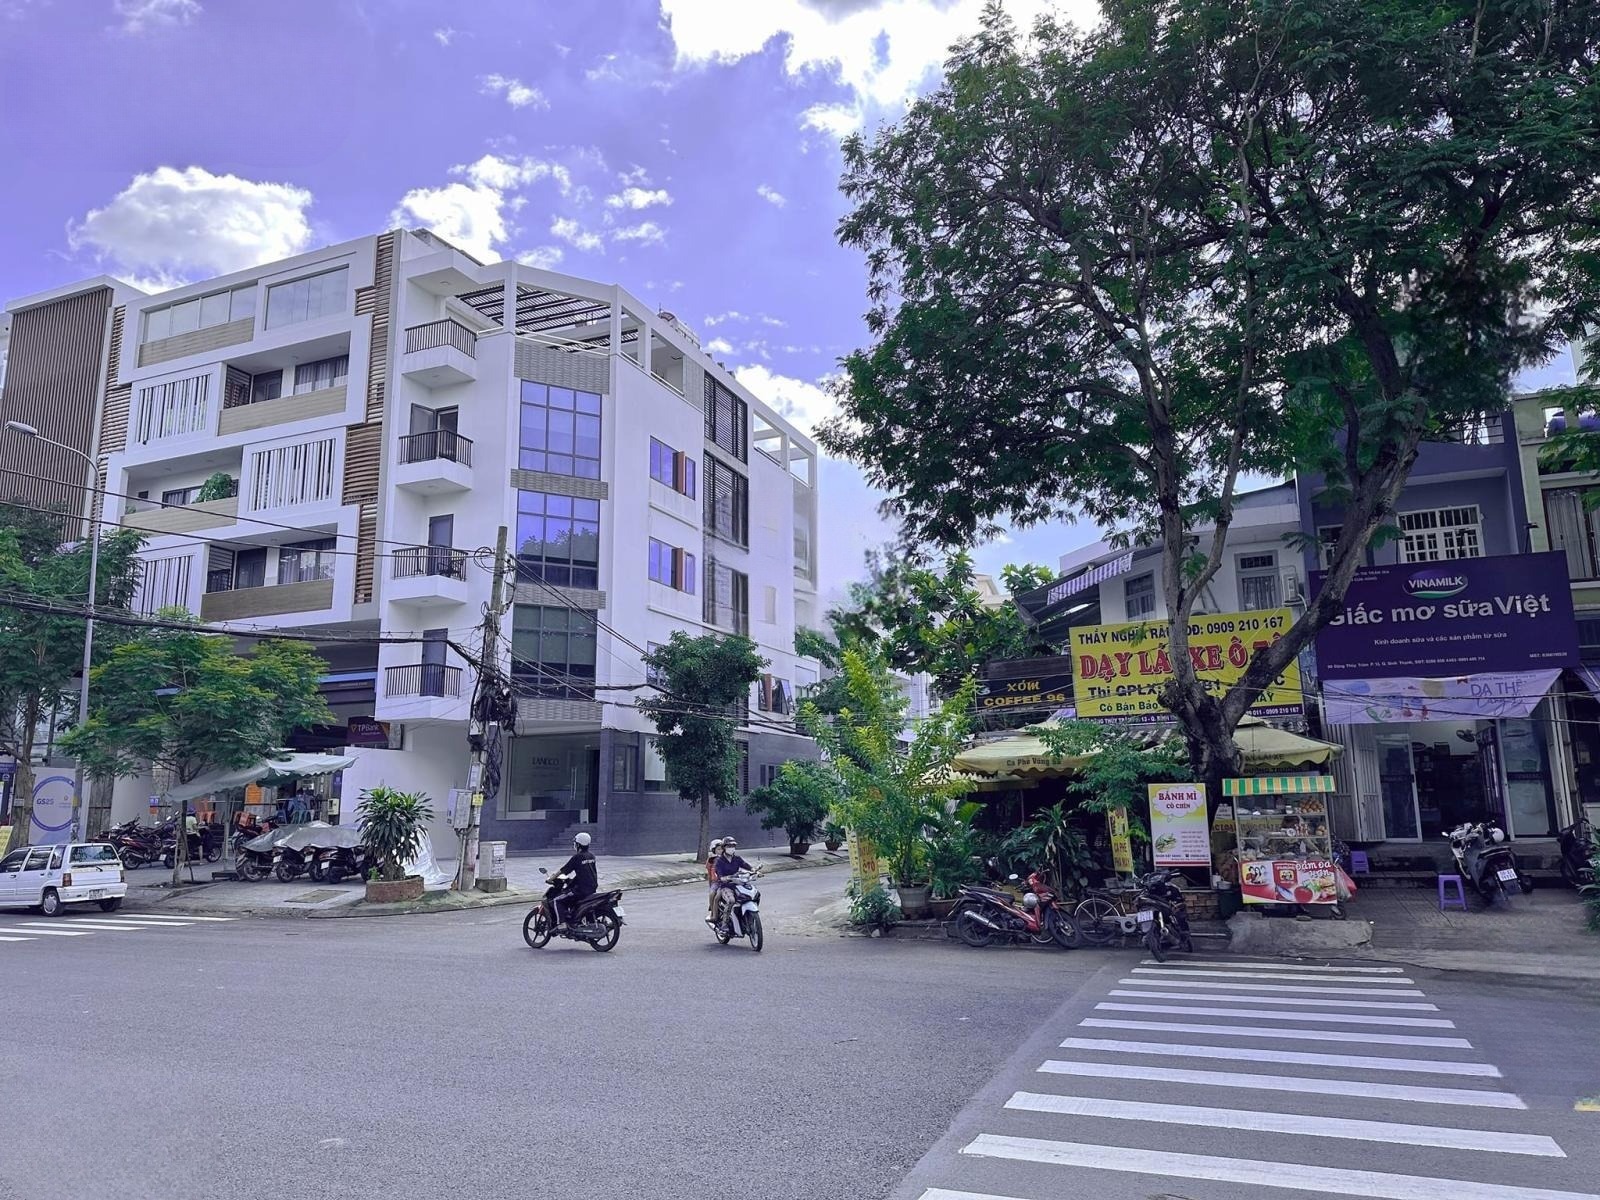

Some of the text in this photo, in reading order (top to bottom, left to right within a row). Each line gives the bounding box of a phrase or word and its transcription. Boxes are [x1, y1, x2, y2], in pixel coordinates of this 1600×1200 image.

[1408, 576, 1463, 589] VINAMILK
[1391, 605, 1436, 622] mơ
[1443, 599, 1494, 618] sữa
[1494, 593, 1550, 618] Việt
[1111, 626, 1148, 643] NGH
[1206, 621, 1235, 634] 0909
[1238, 618, 1260, 632] 210
[1263, 615, 1284, 629] 167
[1080, 651, 1133, 683] DẠY
[1138, 645, 1174, 676] LÁ
[1188, 644, 1225, 672] XE
[1228, 635, 1249, 669] Ô
[1088, 686, 1111, 698] Thi
[983, 693, 1042, 708] COFFEE
[1099, 702, 1113, 712] Có
[1116, 701, 1136, 712] Bán
[36, 798, 55, 806] GS25
[1158, 790, 1197, 801] BÁNH MÌ
